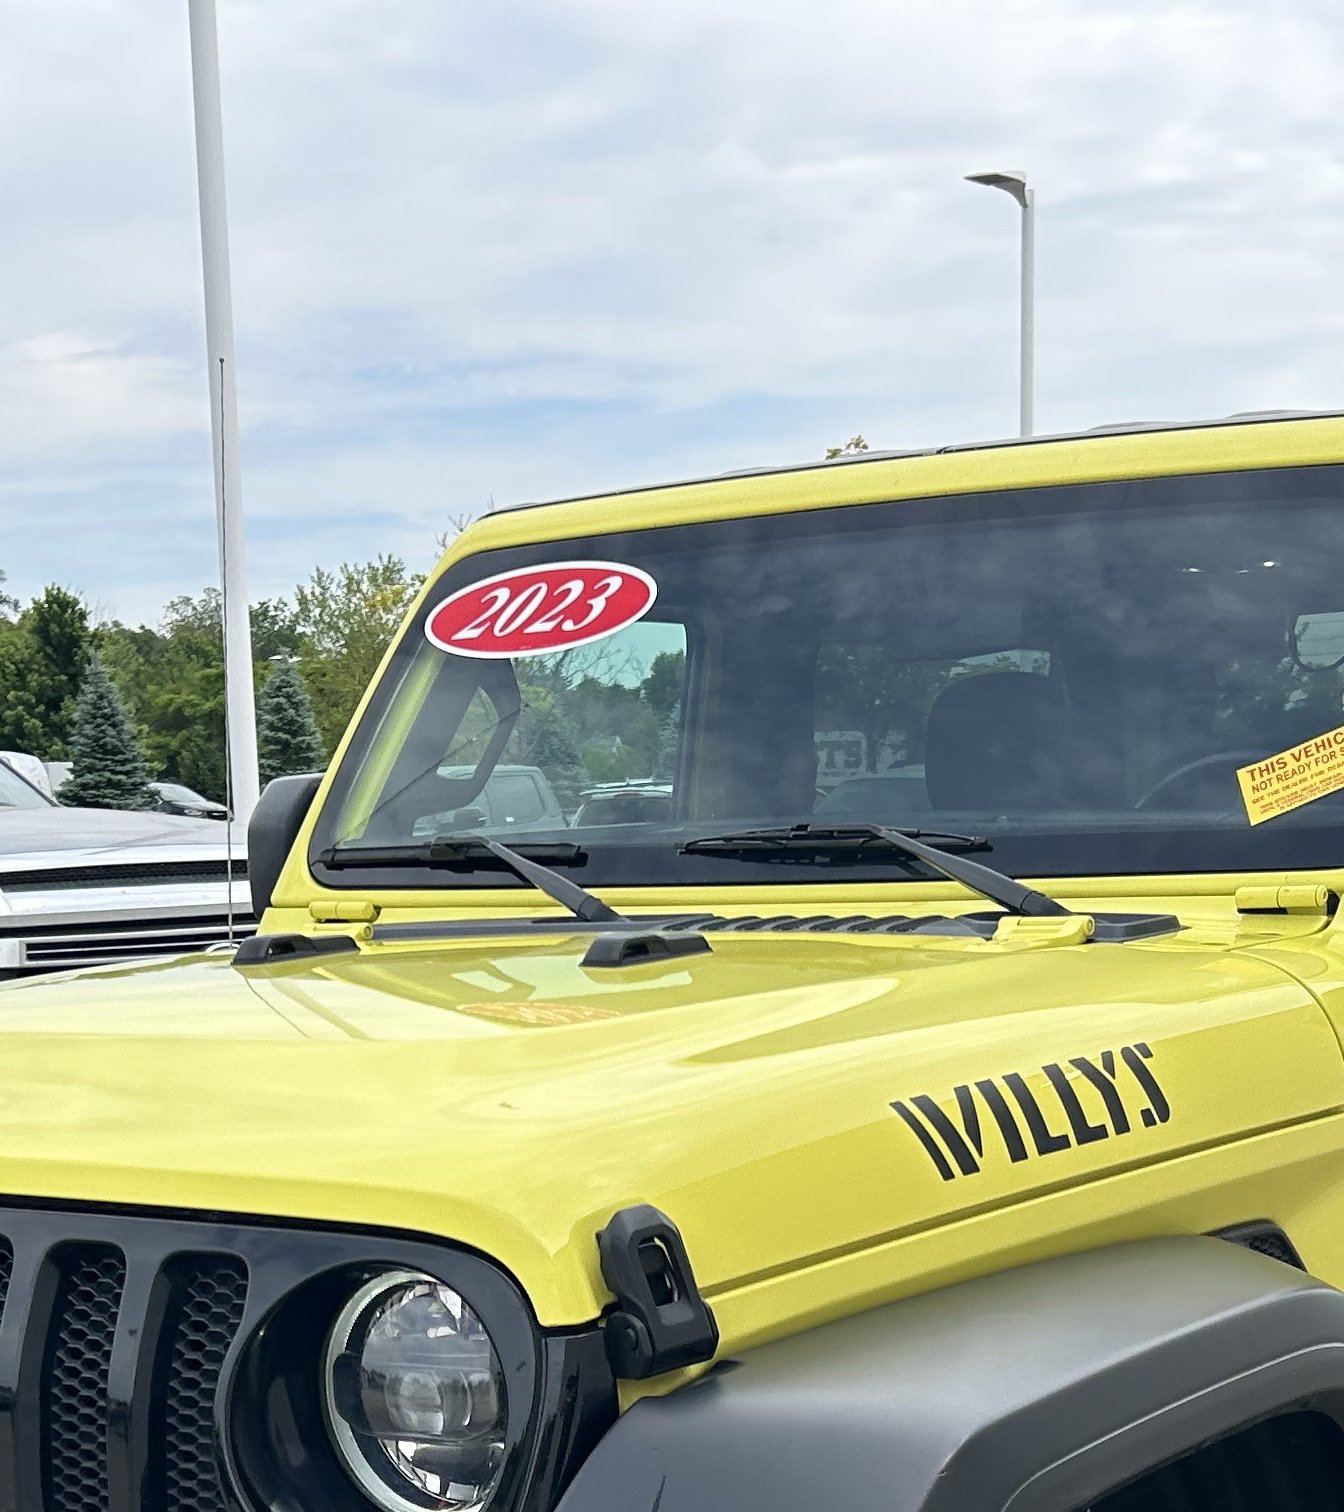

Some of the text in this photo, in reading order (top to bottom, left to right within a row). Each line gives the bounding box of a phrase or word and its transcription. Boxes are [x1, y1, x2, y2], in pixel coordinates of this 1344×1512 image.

[450, 575, 623, 641] 2023
[1246, 756, 1288, 782] THIS
[1251, 779, 1273, 795] NOT
[1276, 761, 1312, 785] READY
[1315, 751, 1338, 767] FOR
[889, 1042, 1170, 1181] WILLYS
